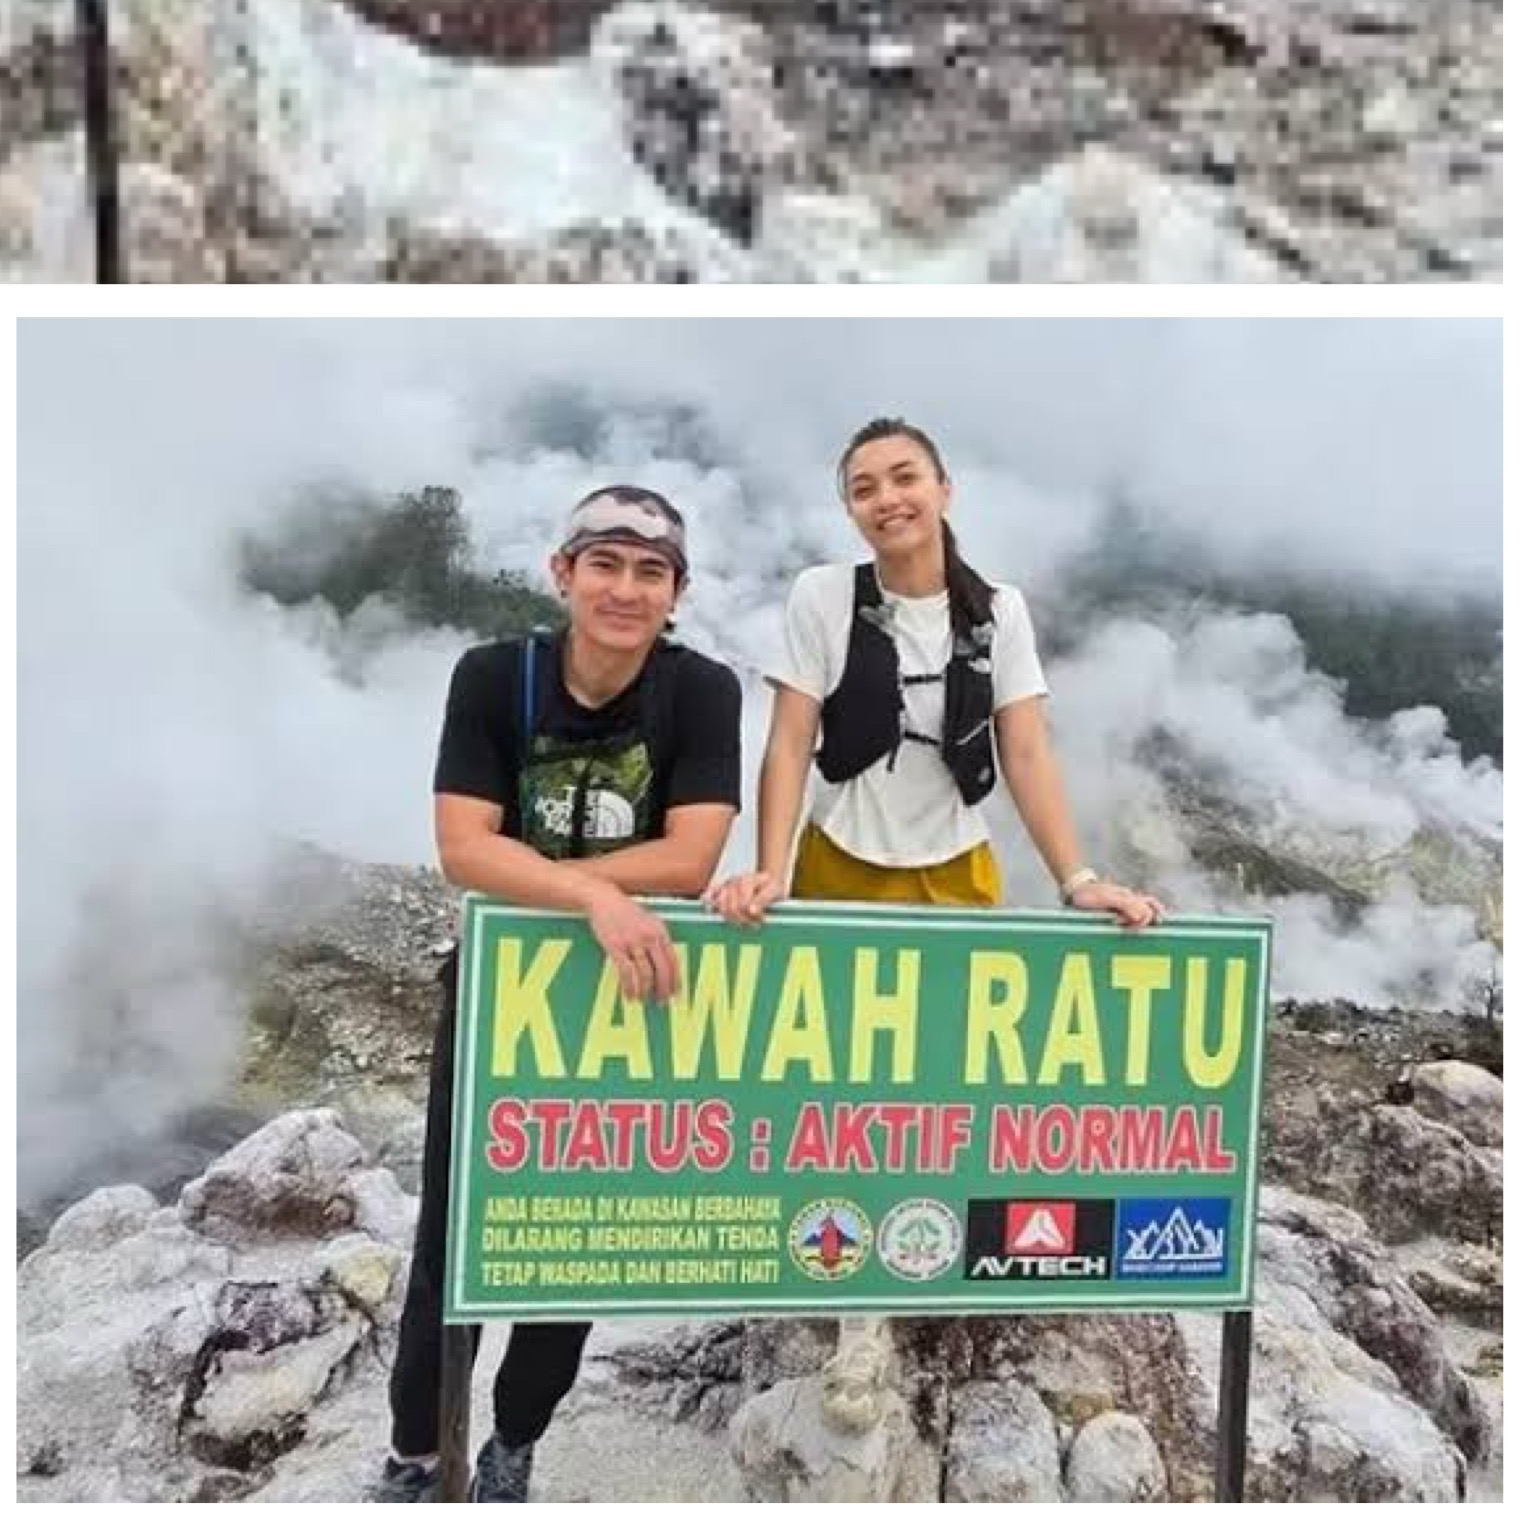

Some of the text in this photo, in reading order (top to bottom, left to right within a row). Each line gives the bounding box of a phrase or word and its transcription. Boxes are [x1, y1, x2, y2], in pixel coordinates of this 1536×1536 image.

[490, 936, 1247, 1090] KAWAH RATU
[485, 1097, 734, 1174] STATUS
[784, 1103, 973, 1174] AKTIF
[990, 1104, 1236, 1174] NORMAL
[482, 1225, 780, 1251] DILARANG MENDIRIKAN TENDA
[482, 1261, 536, 1285] TETAP
[539, 1260, 619, 1285] WASPADA
[740, 1259, 780, 1283] HATI
[970, 1256, 1107, 1276] AVTECH
